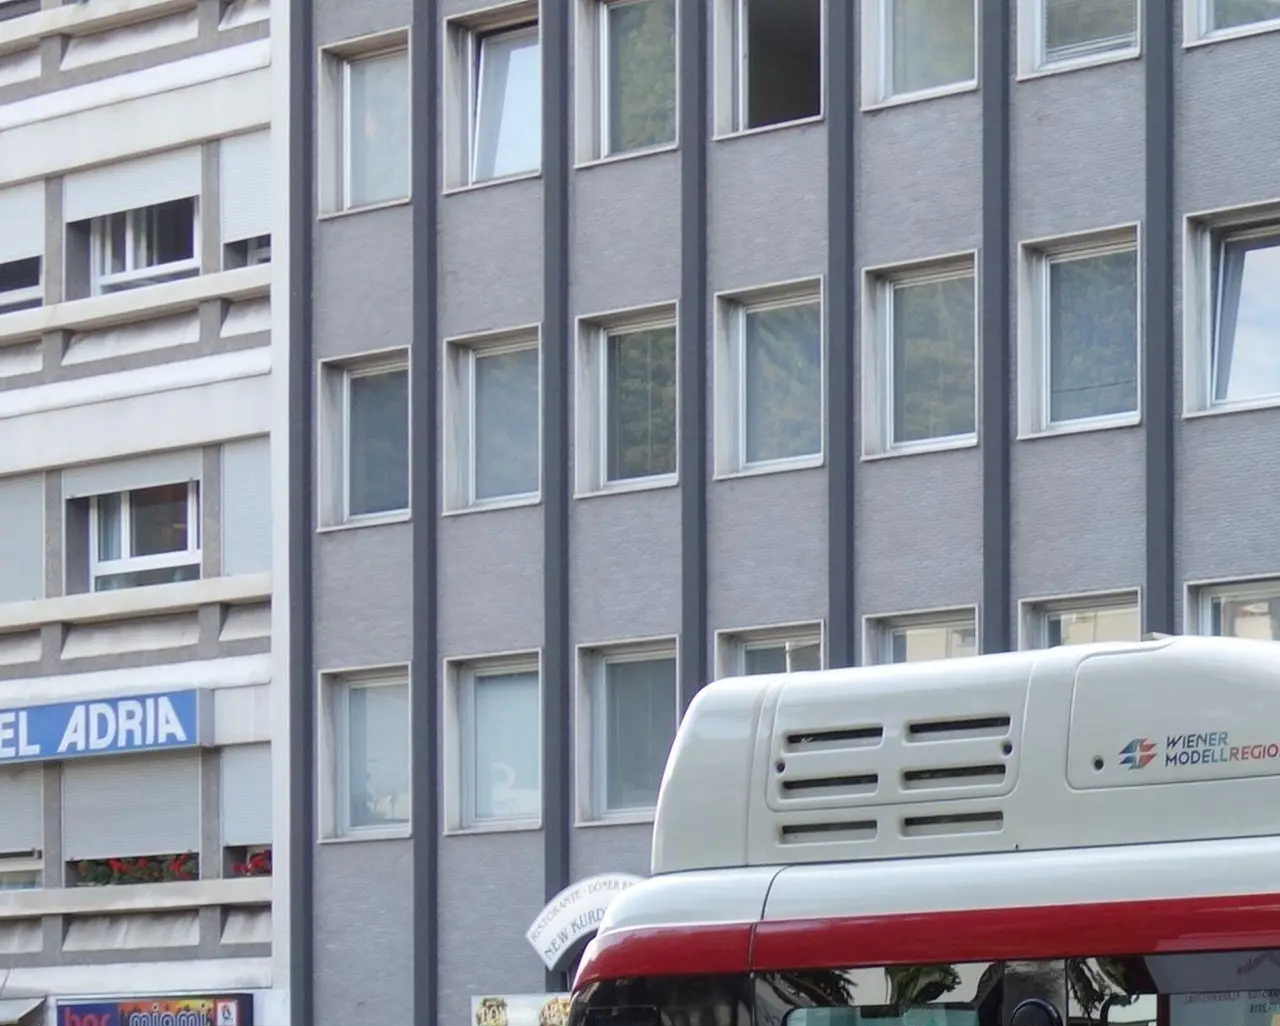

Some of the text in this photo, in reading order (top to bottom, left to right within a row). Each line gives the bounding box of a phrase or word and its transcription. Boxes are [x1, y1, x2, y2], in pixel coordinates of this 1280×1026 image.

[57, 696, 187, 753] ADRIA
[1166, 731, 1229, 749] WIENER
[544, 906, 606, 958] NEW KURD
